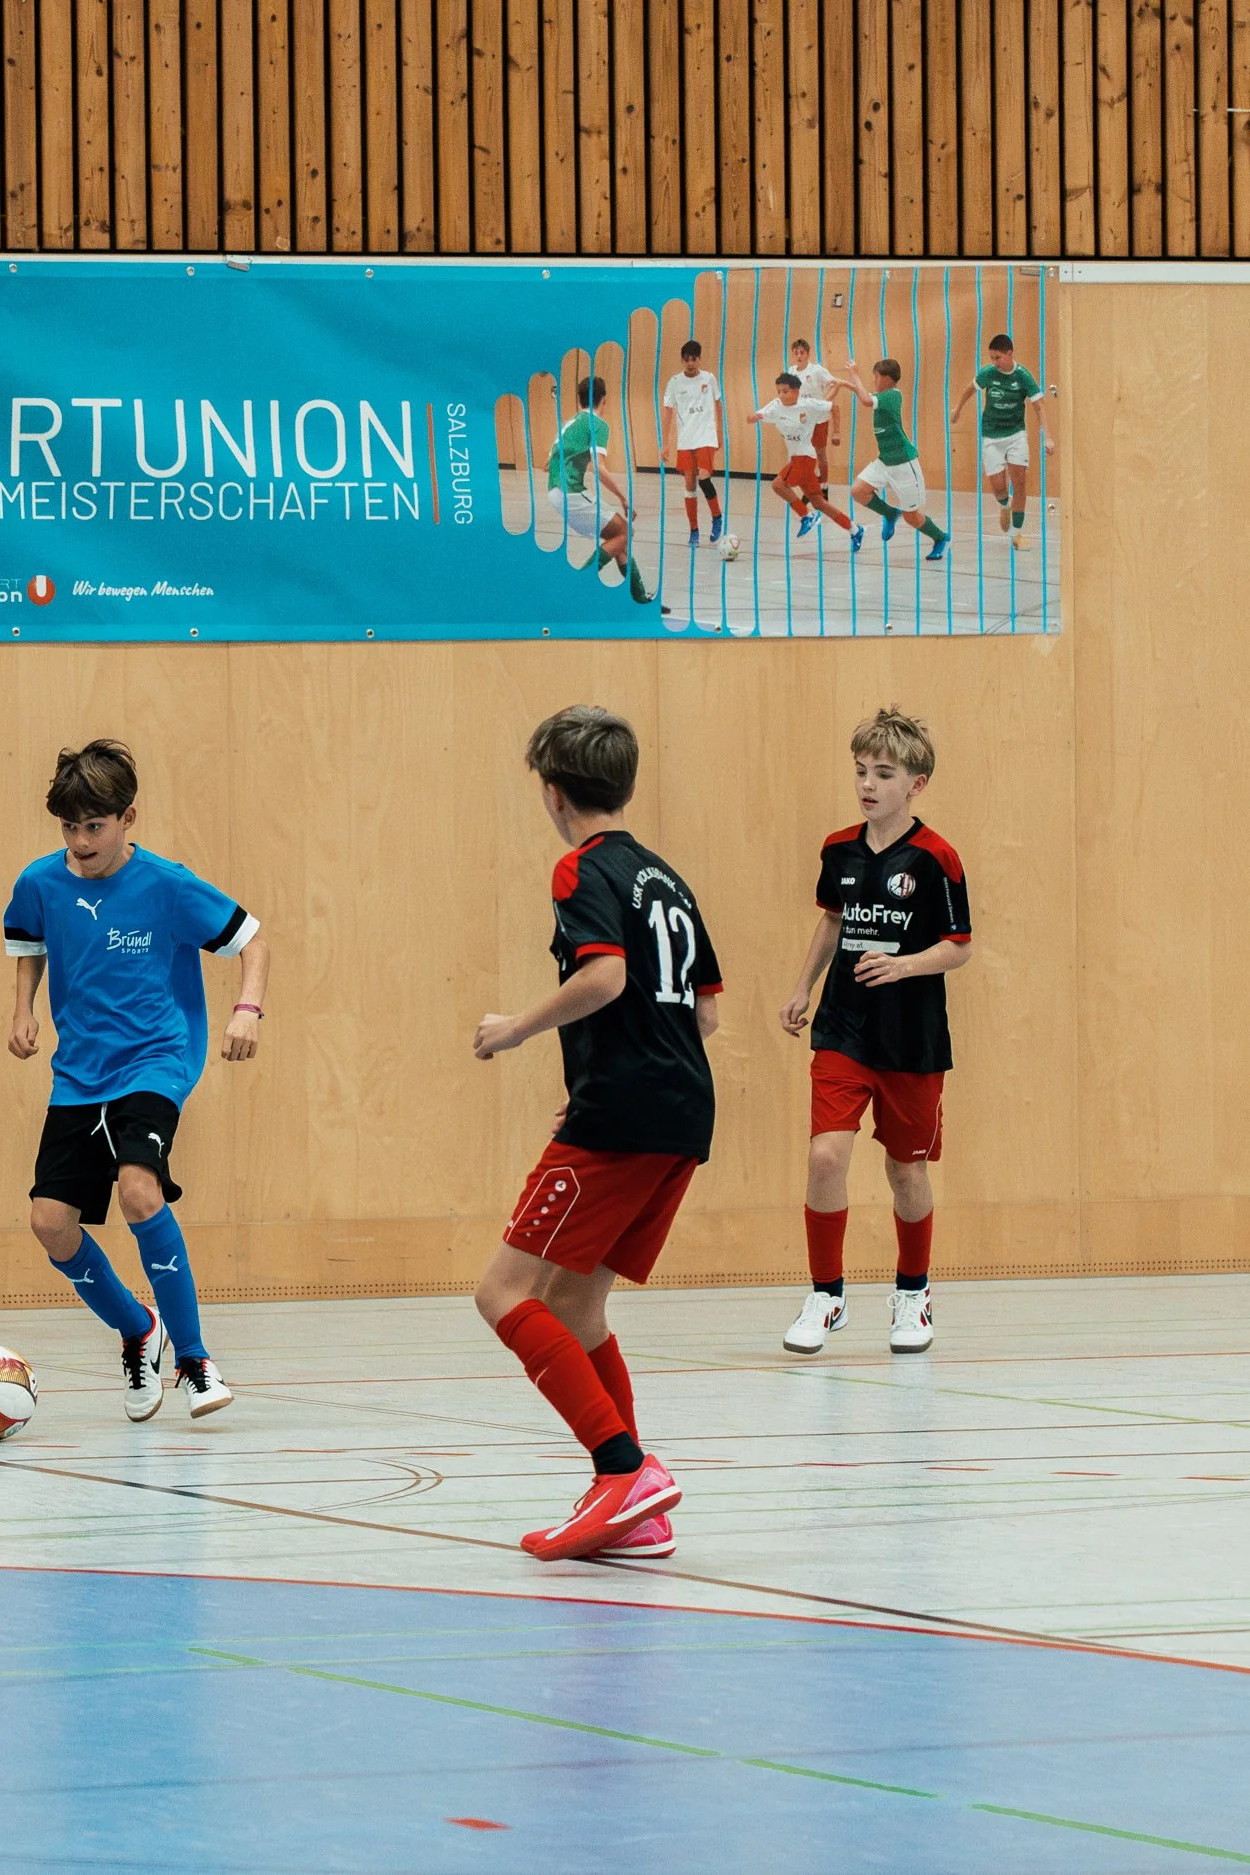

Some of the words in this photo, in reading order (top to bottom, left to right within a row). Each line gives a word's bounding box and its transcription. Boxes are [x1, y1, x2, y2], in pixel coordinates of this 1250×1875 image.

[446, 402, 474, 526] SALZBURG
[72, 580, 97, 596] Wir
[97, 580, 148, 601] bewegen
[150, 580, 215, 597] Menschen
[631, 883, 644, 909] USK
[841, 902, 914, 931] AutoFrey
[648, 899, 697, 1009] 12
